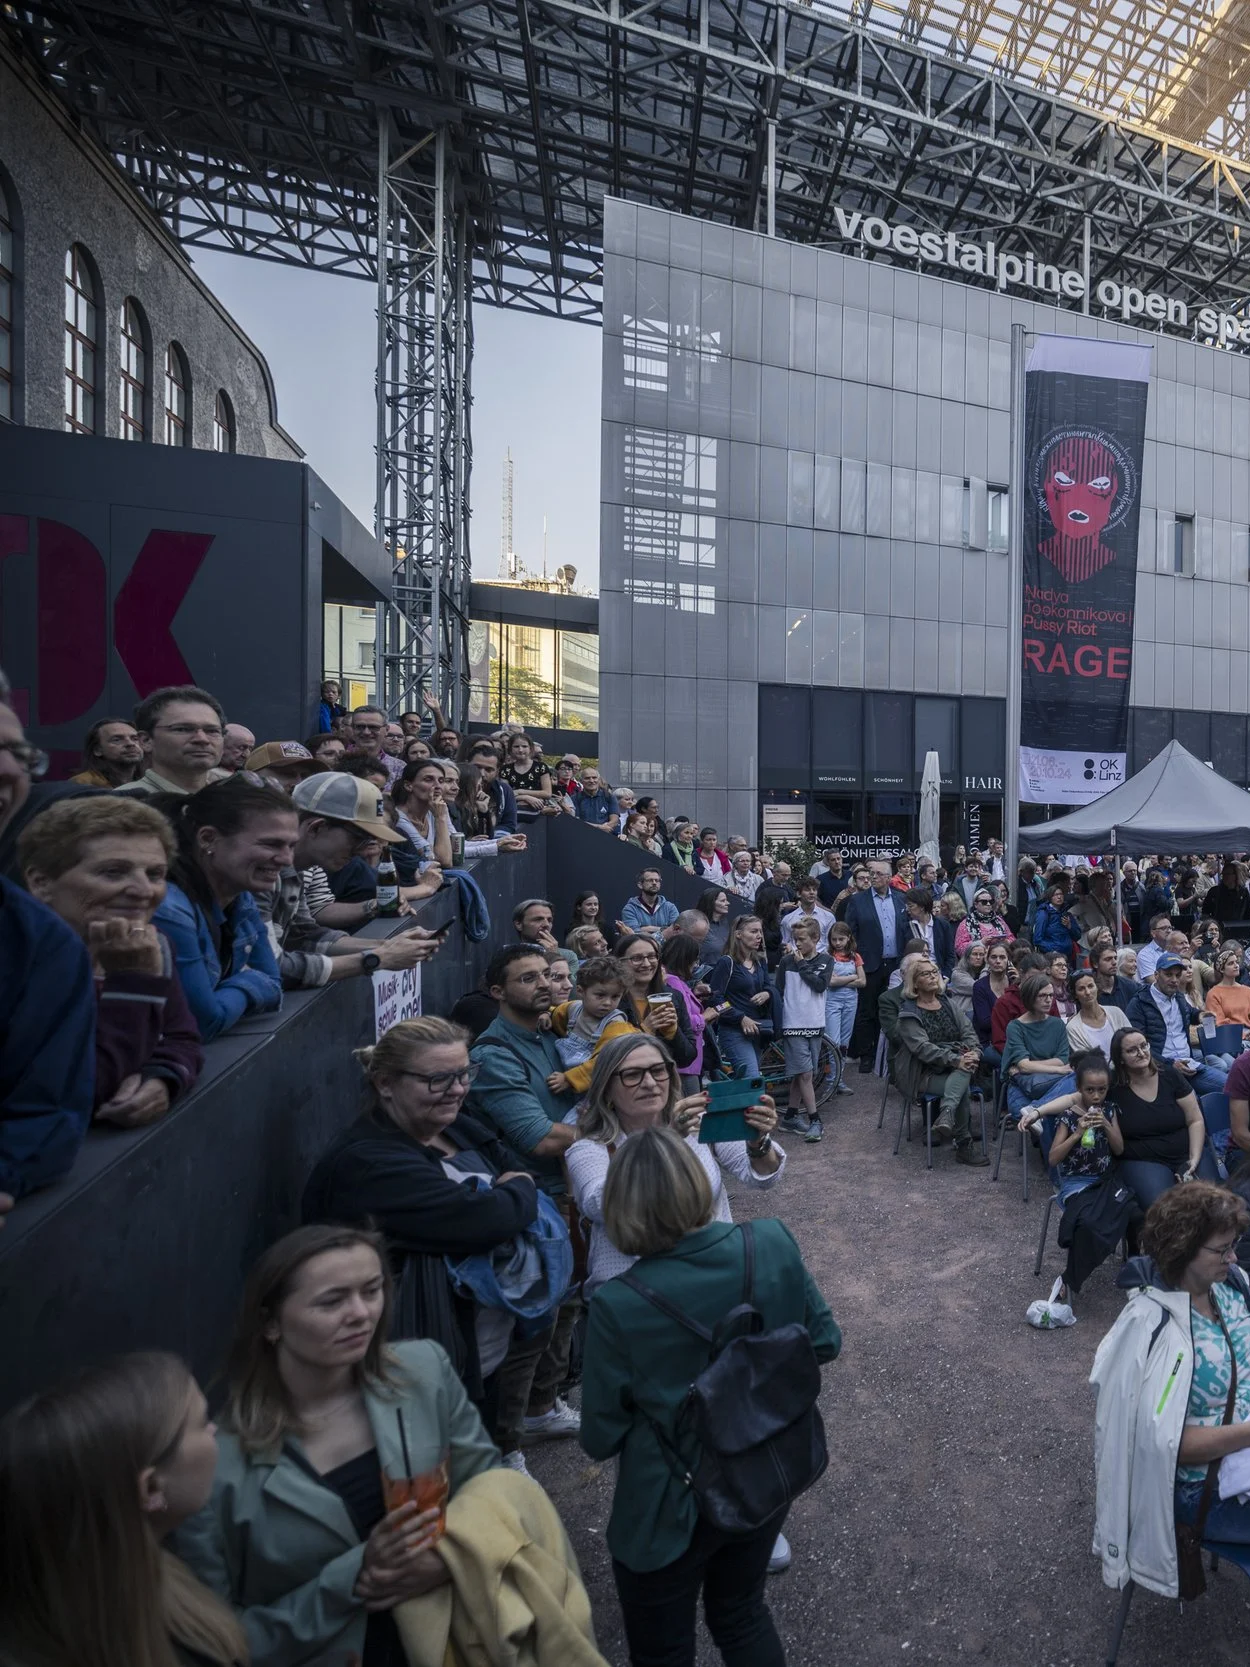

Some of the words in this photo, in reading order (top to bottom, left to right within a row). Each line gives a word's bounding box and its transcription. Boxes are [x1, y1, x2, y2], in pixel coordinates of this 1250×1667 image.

[834, 207, 1086, 299] voestalpine
[1098, 279, 1189, 325] open
[1025, 584, 1069, 604] Nadya
[1023, 614, 1065, 636] Pussy
[1067, 620, 1098, 636] Riot
[1023, 638, 1131, 679] RAGE
[1100, 759, 1118, 770] OK
[965, 776, 1002, 789] HAIR
[1099, 770, 1122, 780] Linz
[815, 833, 900, 845] NATÜRLICHER
[378, 974, 400, 1007] Musik-
[377, 1000, 397, 1033] schule
[783, 1028, 820, 1036] download
